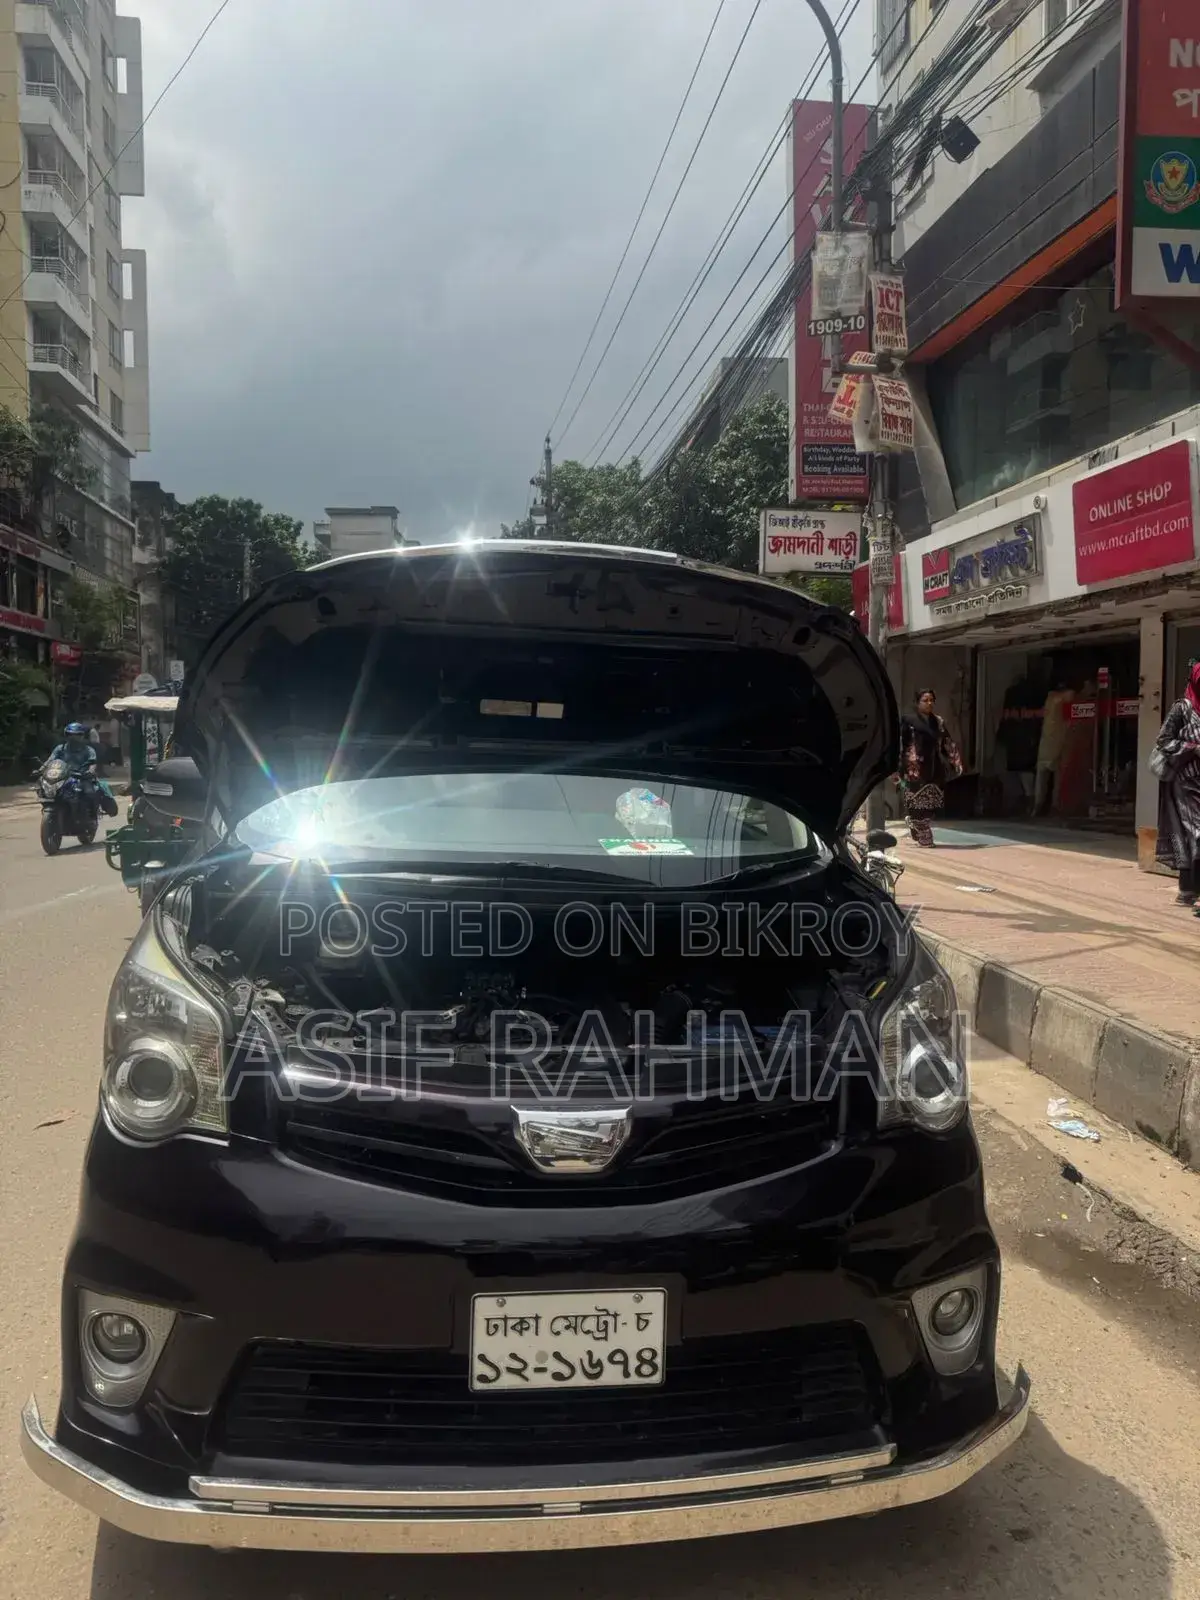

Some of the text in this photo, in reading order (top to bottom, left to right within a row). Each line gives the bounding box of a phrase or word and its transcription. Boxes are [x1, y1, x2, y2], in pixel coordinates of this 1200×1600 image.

[877, 286, 904, 312] ICT
[808, 315, 865, 336] 1909-10
[1089, 481, 1172, 522] ONLINE SHOP
[768, 530, 858, 560] জামদানী শাড়ী
[1078, 515, 1190, 557] www.mcraftbd.com
[484, 1313, 542, 1337] ঢাকা
[635, 1312, 653, 1332] চ
[476, 1347, 659, 1384] ১২-১৬৭৪
